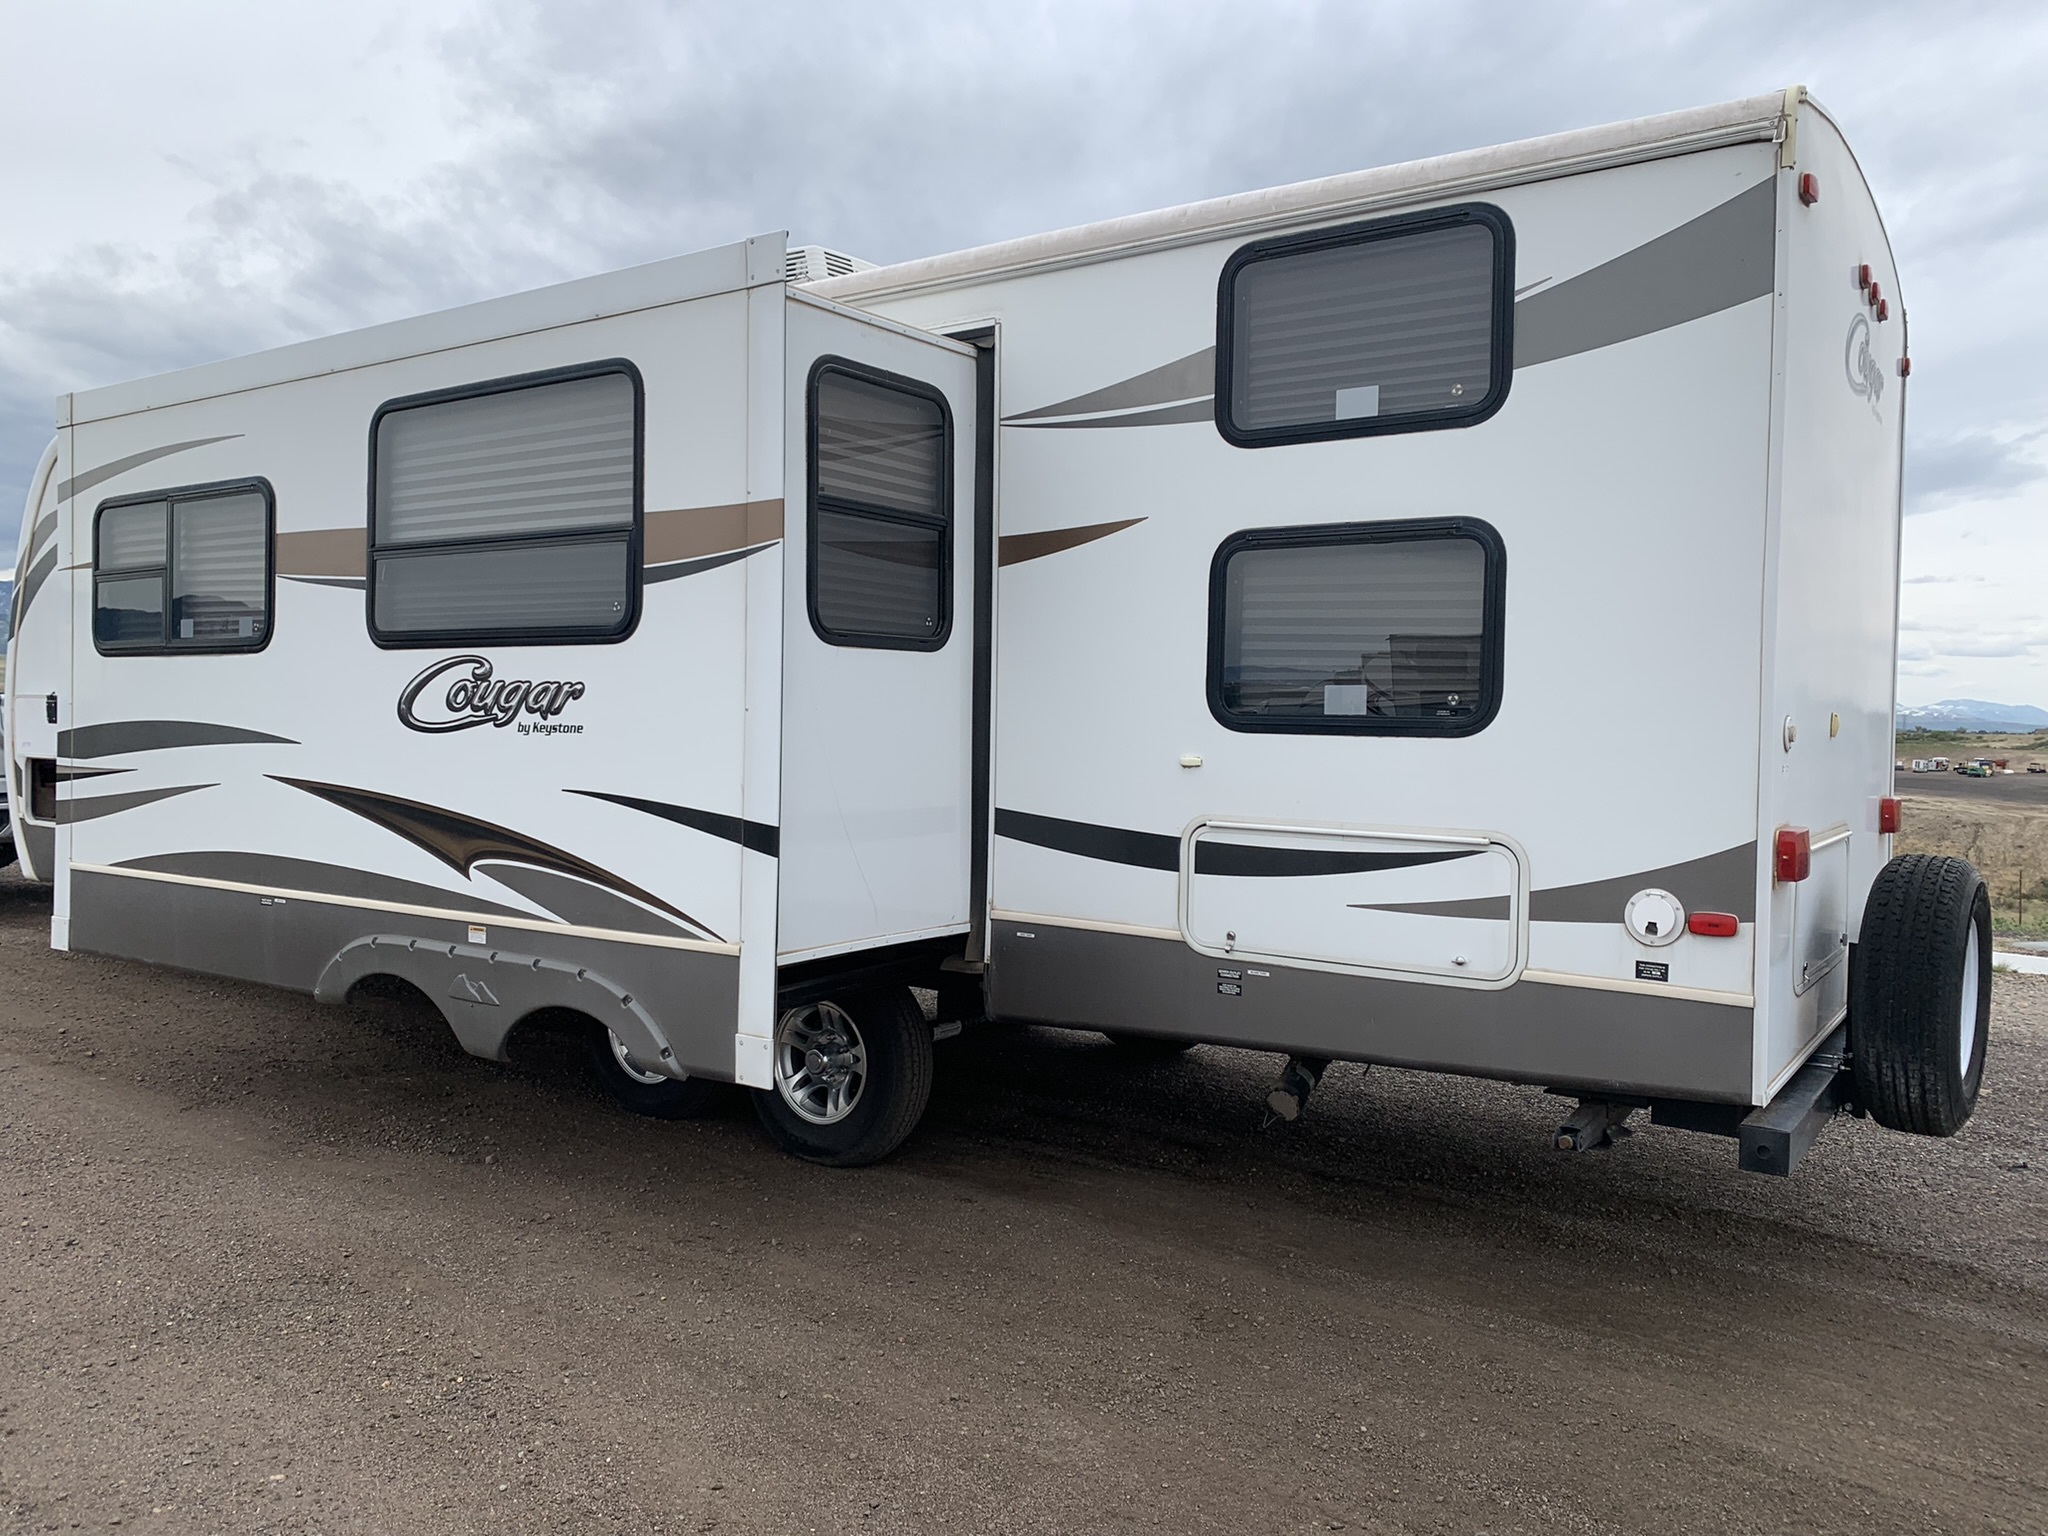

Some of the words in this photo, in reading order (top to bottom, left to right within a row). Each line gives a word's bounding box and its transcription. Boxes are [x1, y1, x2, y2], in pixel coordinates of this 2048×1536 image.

[397, 654, 585, 734] Cougar
[517, 722, 531, 736] by
[532, 722, 584, 736] Keystone
